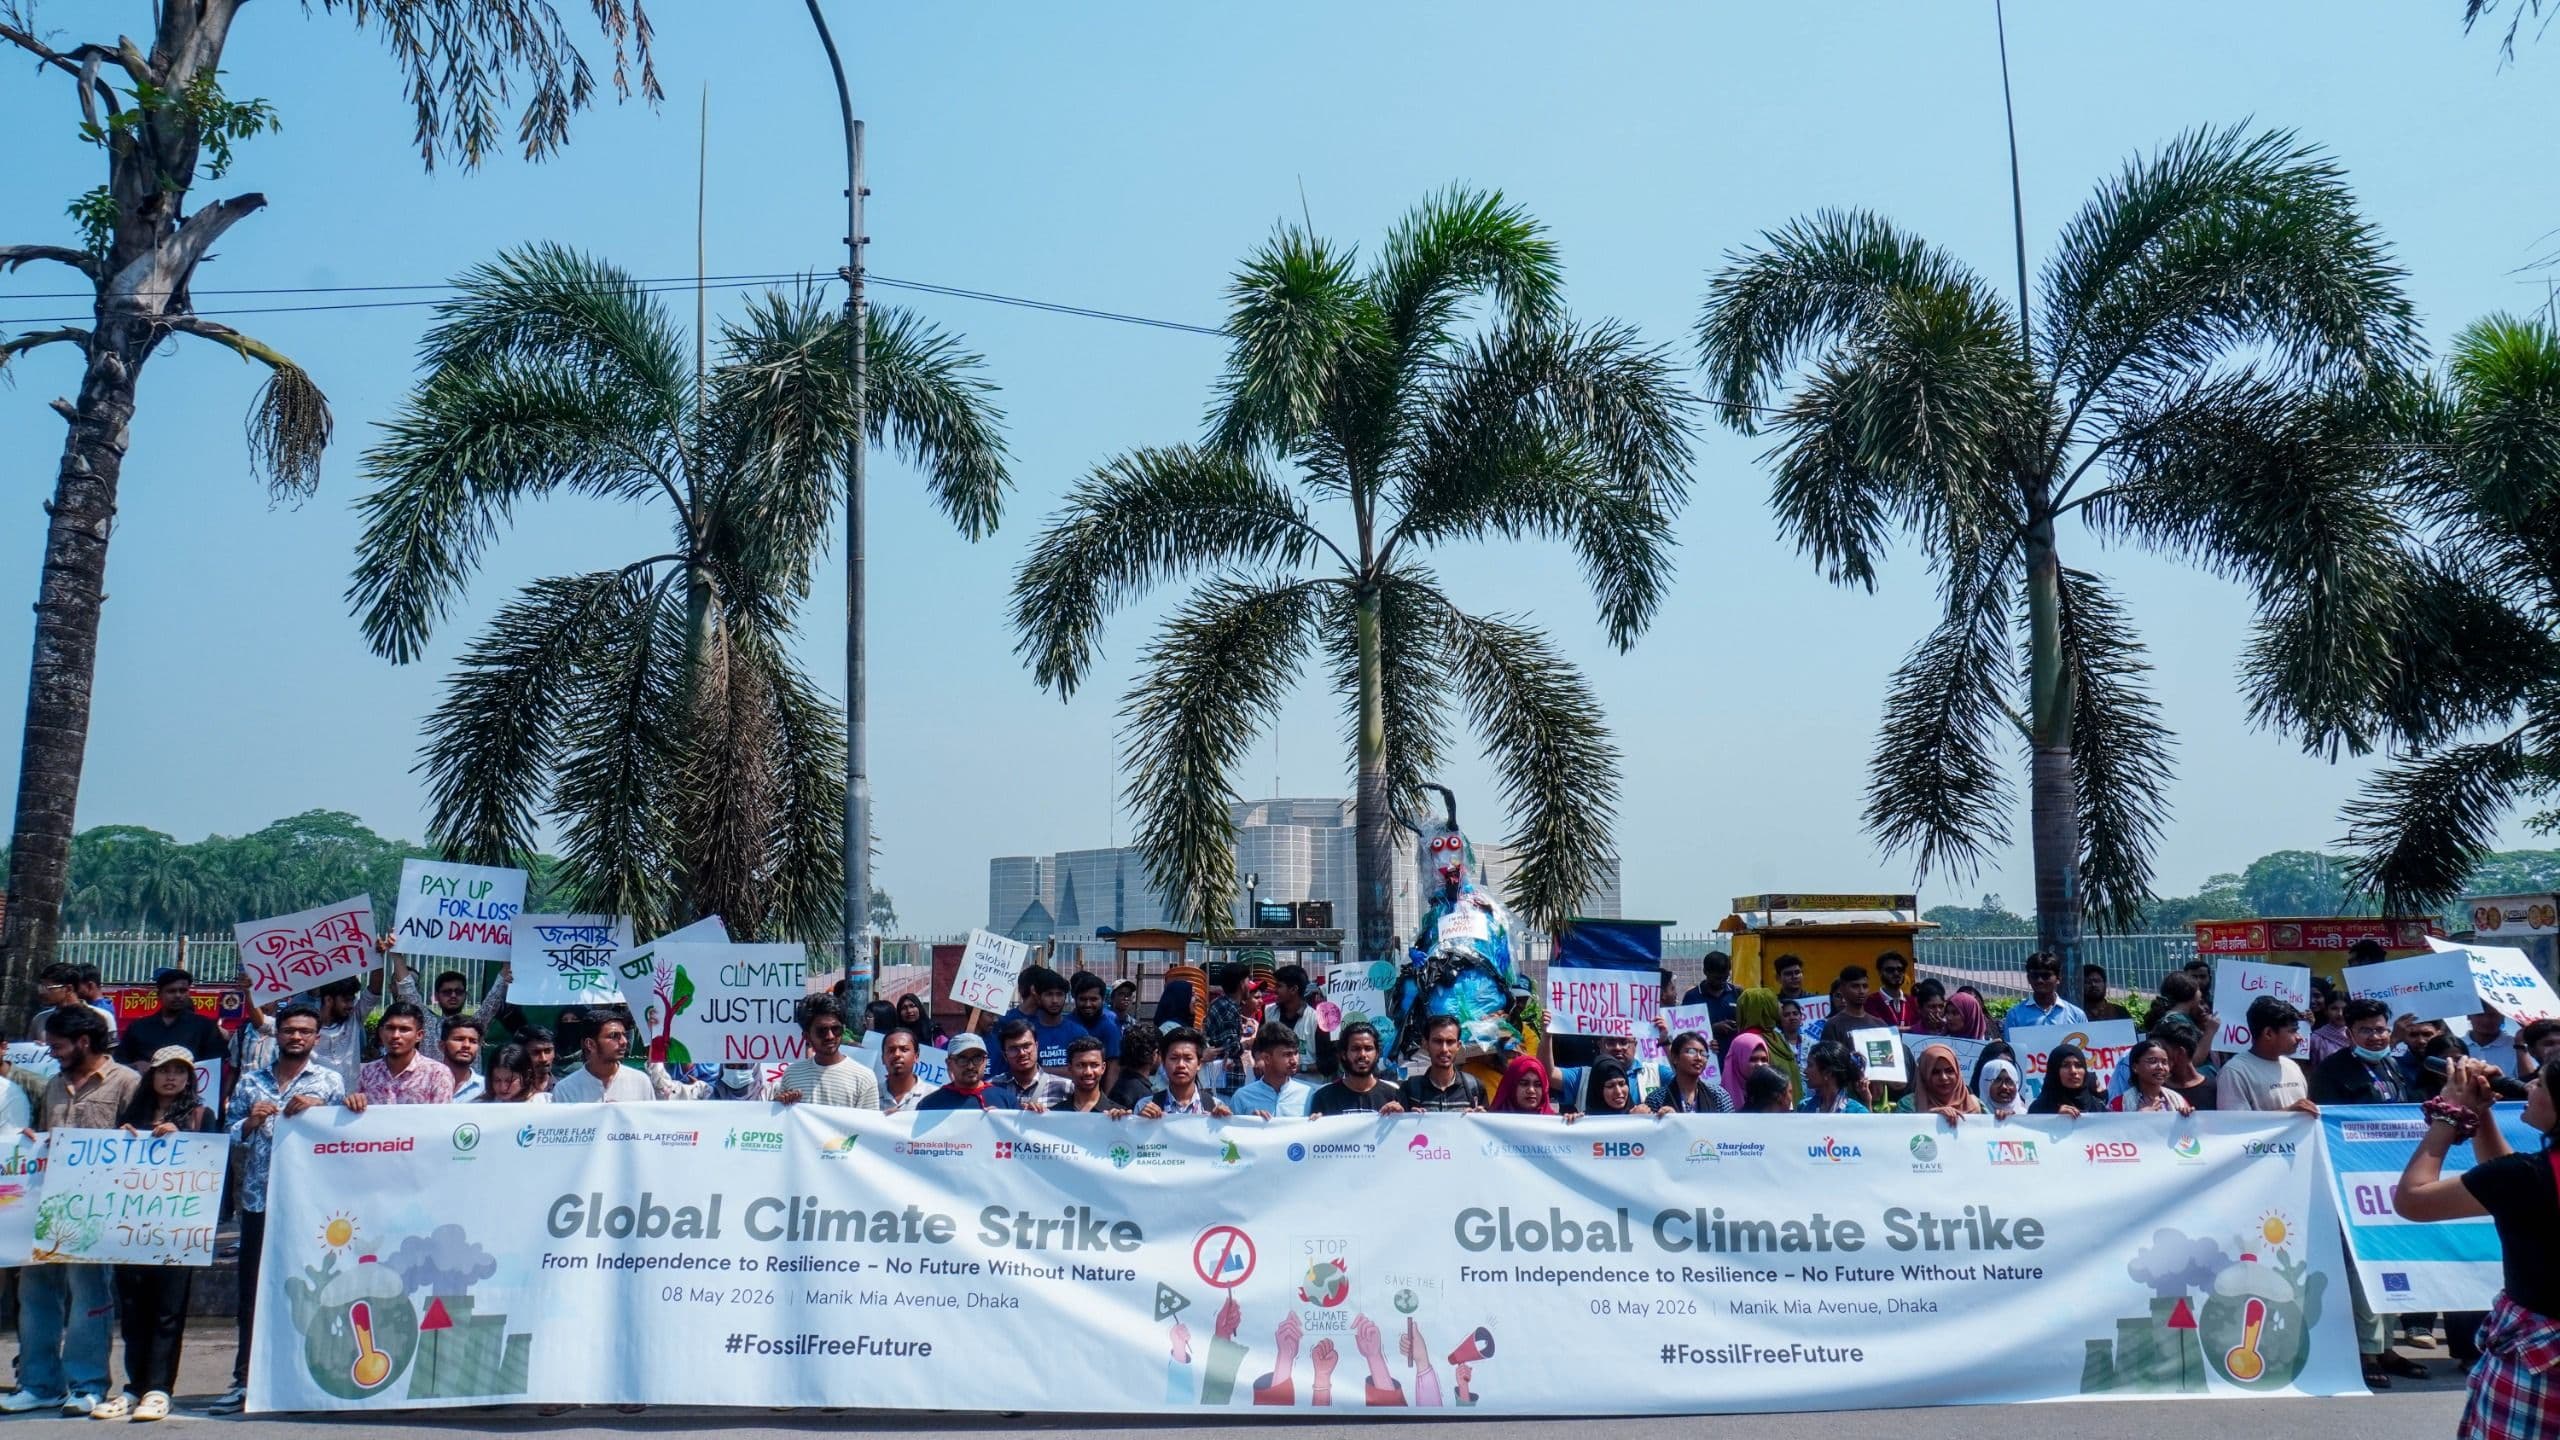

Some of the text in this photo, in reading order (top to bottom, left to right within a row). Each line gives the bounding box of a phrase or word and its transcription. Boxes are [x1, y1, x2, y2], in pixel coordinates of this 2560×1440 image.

[420, 875, 493, 899] PAY UP
[439, 898, 518, 921] FOR LOSS
[399, 917, 512, 946] AND DAMAG
[975, 934, 1017, 959] LIMIT
[975, 951, 1011, 970] Global
[720, 961, 807, 988] CLIMATE
[973, 971, 986, 983] to
[975, 962, 1018, 985] warming
[2491, 969, 2536, 988] Crisis
[1576, 1015, 1634, 1036] FUTURE
[725, 1035, 809, 1060] NOW
[1040, 1049, 1067, 1058] CLIMATE
[536, 1135, 595, 1144] FOUNDATION
[538, 1127, 597, 1136] FUTURE FLARE
[607, 1133, 641, 1142] GLOBAL
[741, 1131, 784, 1144] GPYDS
[68, 1138, 190, 1166] JUSTICE
[1014, 1142, 1078, 1154] KASHFUL
[1136, 1143, 1168, 1151] MISSION
[1313, 1144, 1361, 1153] ODOMMO
[1415, 1147, 1451, 1160] sada
[1592, 1142, 1645, 1157] SHBO
[122, 1169, 221, 1194] JUSTICE
[66, 1192, 201, 1221] CLIMATE
[546, 1192, 1143, 1253] Global Climate Strike
[1454, 1205, 2045, 1252] Global Climate Strike
[117, 1225, 214, 1254] JUSTICE
[1304, 1240, 1348, 1255] STOP
[542, 1253, 588, 1270] From
[596, 1253, 731, 1274] Independence
[739, 1256, 759, 1272] to
[766, 1256, 860, 1273] Resilience
[886, 1258, 913, 1275] No
[920, 1258, 980, 1276] Future
[988, 1259, 1064, 1280] Without
[1072, 1264, 1136, 1282] Nature
[1461, 1266, 1508, 1282] From
[1515, 1265, 1650, 1286] Independence
[1656, 1267, 1675, 1282] to
[1682, 1265, 1778, 1283] Resilience
[1802, 1266, 1828, 1282] No
[1836, 1265, 1895, 1282] Future
[1901, 1264, 1976, 1281] Without
[1983, 1264, 2043, 1280] Nature
[662, 1286, 1019, 1309] 08 May 2026 Manik Mia Avenue, Dhaka
[1304, 1310, 1348, 1321] CLIMATE
[1590, 1298, 1938, 1318] 08 May 2026 Manik Mia Avenue, Dhaka
[1304, 1321, 1348, 1331] CHANGE
[725, 1333, 932, 1358] #FossilFreeFuture
[1661, 1344, 1864, 1364] #FossilFreeFuture
